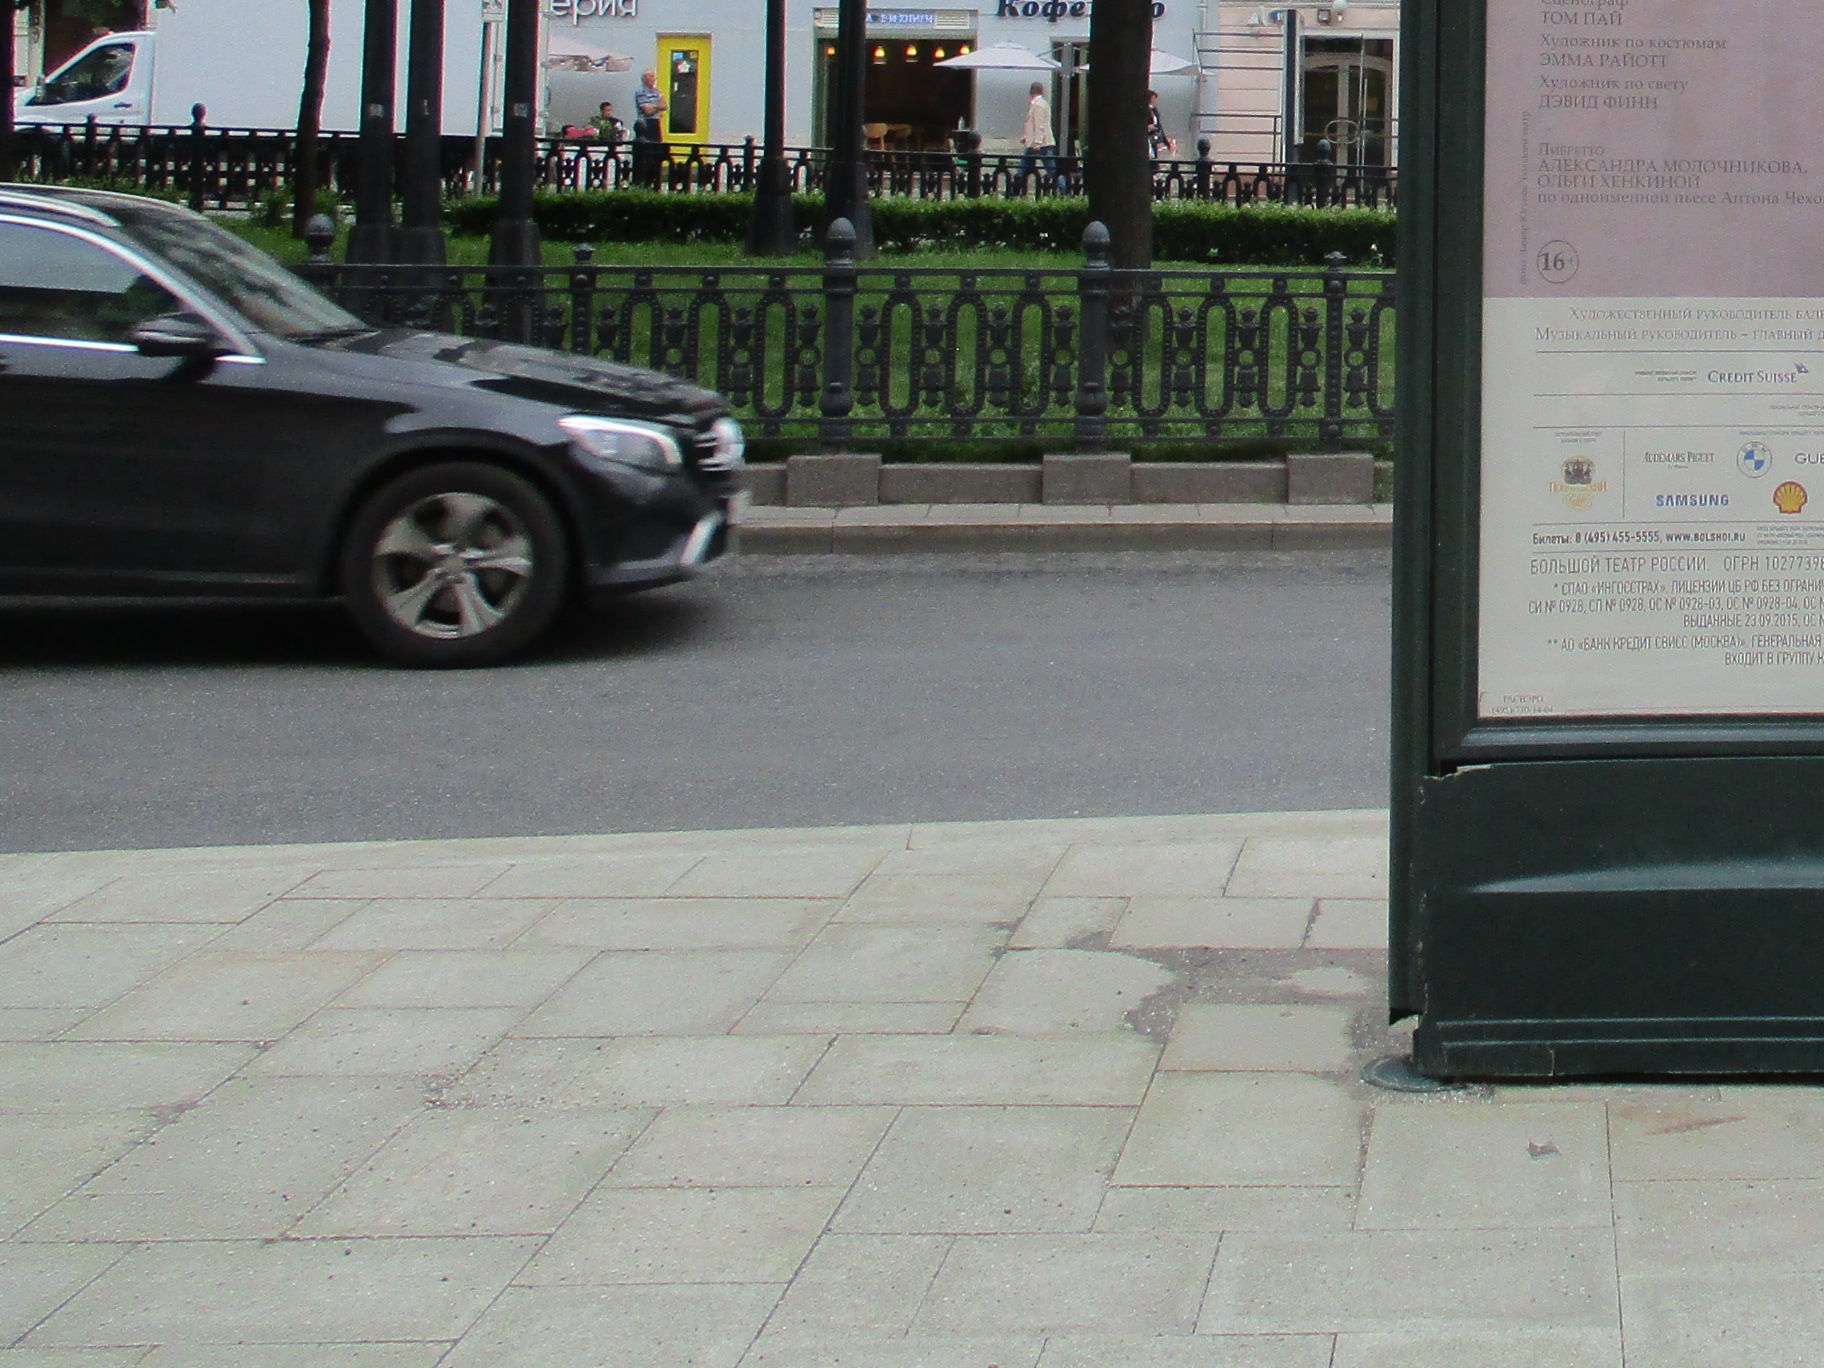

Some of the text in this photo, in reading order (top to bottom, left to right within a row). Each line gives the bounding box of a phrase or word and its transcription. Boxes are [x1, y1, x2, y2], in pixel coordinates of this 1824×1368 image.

[1541, 10, 1623, 27] ТОМ ПАЙ
[1540, 33, 1728, 51] Художник по костюмам
[1539, 52, 1595, 68] ЭММА
[1539, 74, 1620, 93] Художник
[1538, 94, 1659, 111] ДЭВИД ФИНН
[1537, 158, 1808, 175] АЛЕКСАНДРА МОЛОЧНИКОВА,
[1537, 173, 1700, 190] ОЛЬГИ ХЕНКИНОЙ
[1537, 193, 1557, 204] по
[1561, 192, 1670, 206] одноименной
[1674, 192, 1716, 205] пьесе
[1721, 191, 1780, 206] Антона
[1696, 309, 1791, 321] РУКОВОДИТЕЛЬ
[1641, 330, 1737, 342] РУКОВОДИТЕЛЬ
[1655, 493, 1730, 507] SAMSUNG
[1532, 532, 1573, 546] Билеты:
[1575, 532, 1582, 543] 8
[1583, 531, 1611, 544] (495)
[1612, 530, 1663, 544] 455-5555,
[1530, 554, 1600, 575] БОЛЬШОЙ
[1605, 558, 1647, 573] ТЕАТР
[1650, 557, 1711, 572] РОССИИ.
[1723, 556, 1760, 572] ОГРН
[1561, 581, 1588, 595] СПАО
[1671, 580, 1726, 595] ЛИЦЕНЗИИ
[1744, 579, 1759, 593] РФ
[1761, 579, 1781, 592] БЕЗ
[1683, 614, 1742, 629] ВЫДАННЫЕ
[1613, 636, 1652, 652] КРЕДИТ
[1654, 635, 1689, 649] СВИСС
[1751, 634, 1822, 649] ГЕНЕРАЛЬНАЯ
[1724, 652, 1764, 667] ВХОДИТ
[1776, 651, 1815, 665] ГРУППУ
